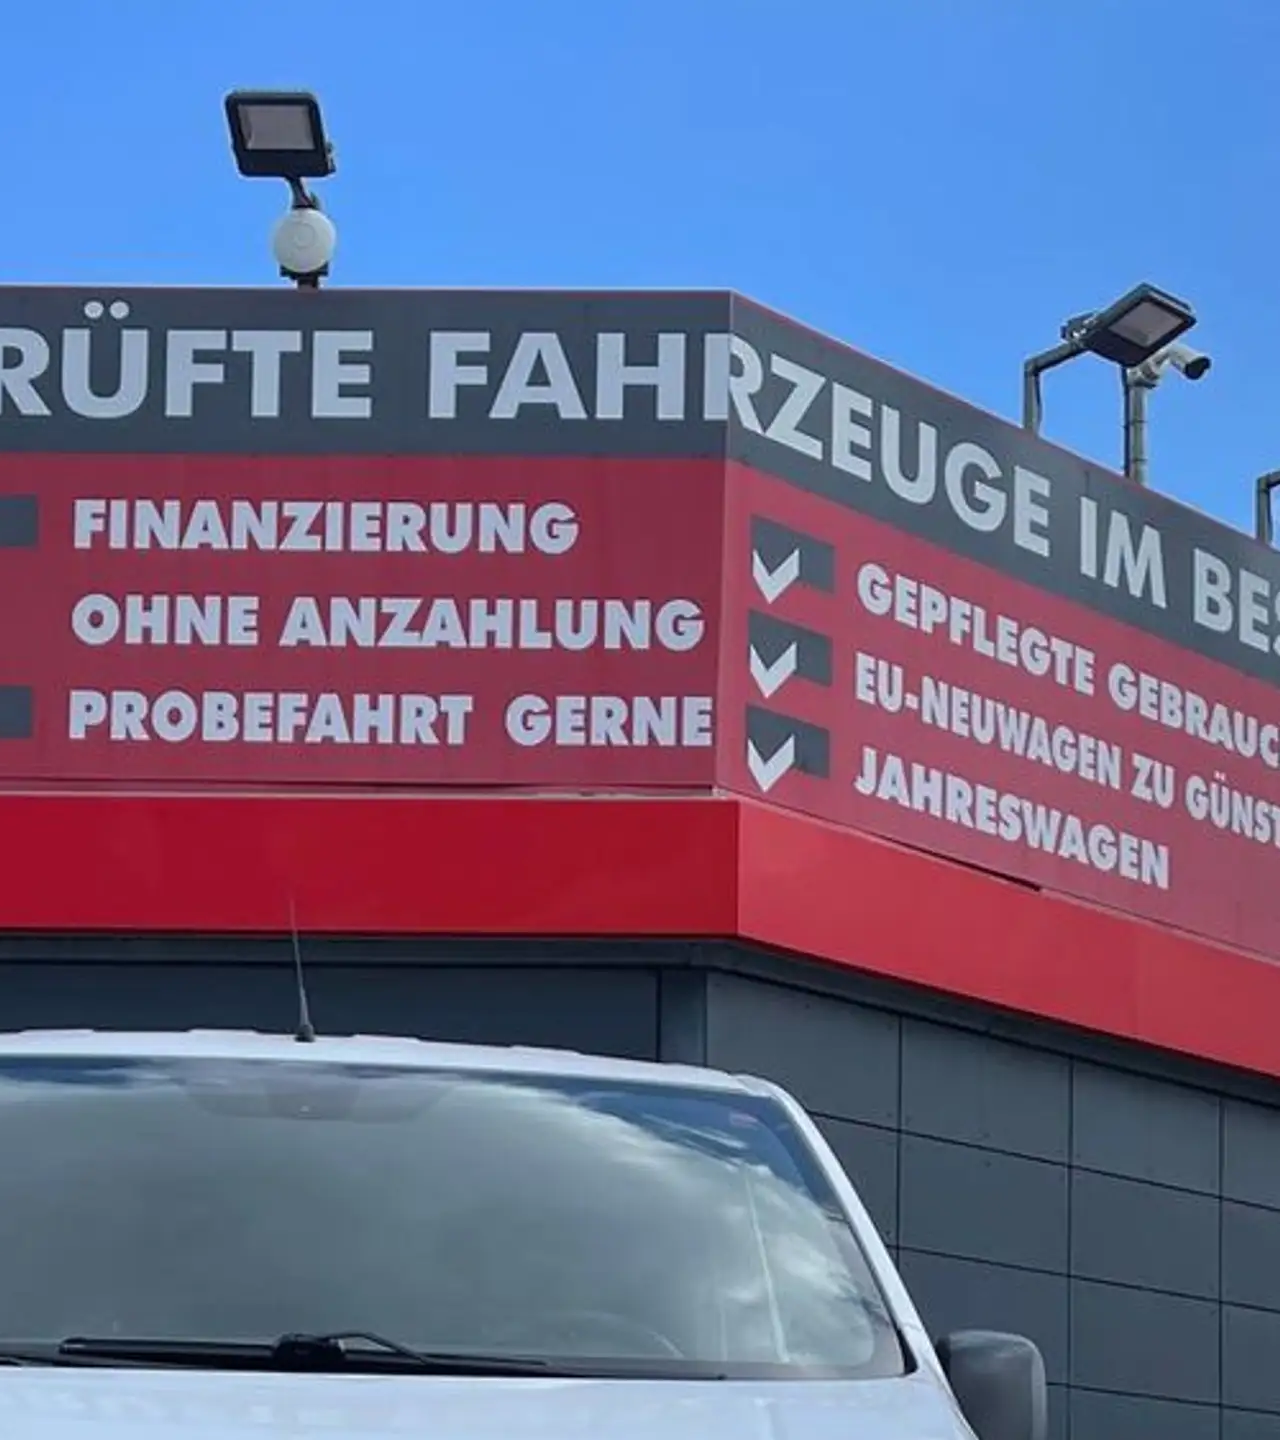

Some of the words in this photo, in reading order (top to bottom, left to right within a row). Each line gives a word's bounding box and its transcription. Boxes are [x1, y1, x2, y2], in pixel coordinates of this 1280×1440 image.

[72, 498, 579, 554] FINANZIERUNG
[428, 331, 1051, 557] FAHRZEUGE
[1079, 496, 1169, 610] IM
[71, 594, 259, 647] OHNE
[279, 597, 707, 652] ANZAHLUNG
[856, 563, 1096, 697] GEPFLEGTE
[68, 689, 474, 746] PROBEFAHRT
[505, 693, 714, 748] GERNE
[854, 651, 1121, 787] EU-NEUWAGEN
[1131, 753, 1175, 810] ZU
[854, 747, 1170, 889] JAHRESWAGEN
